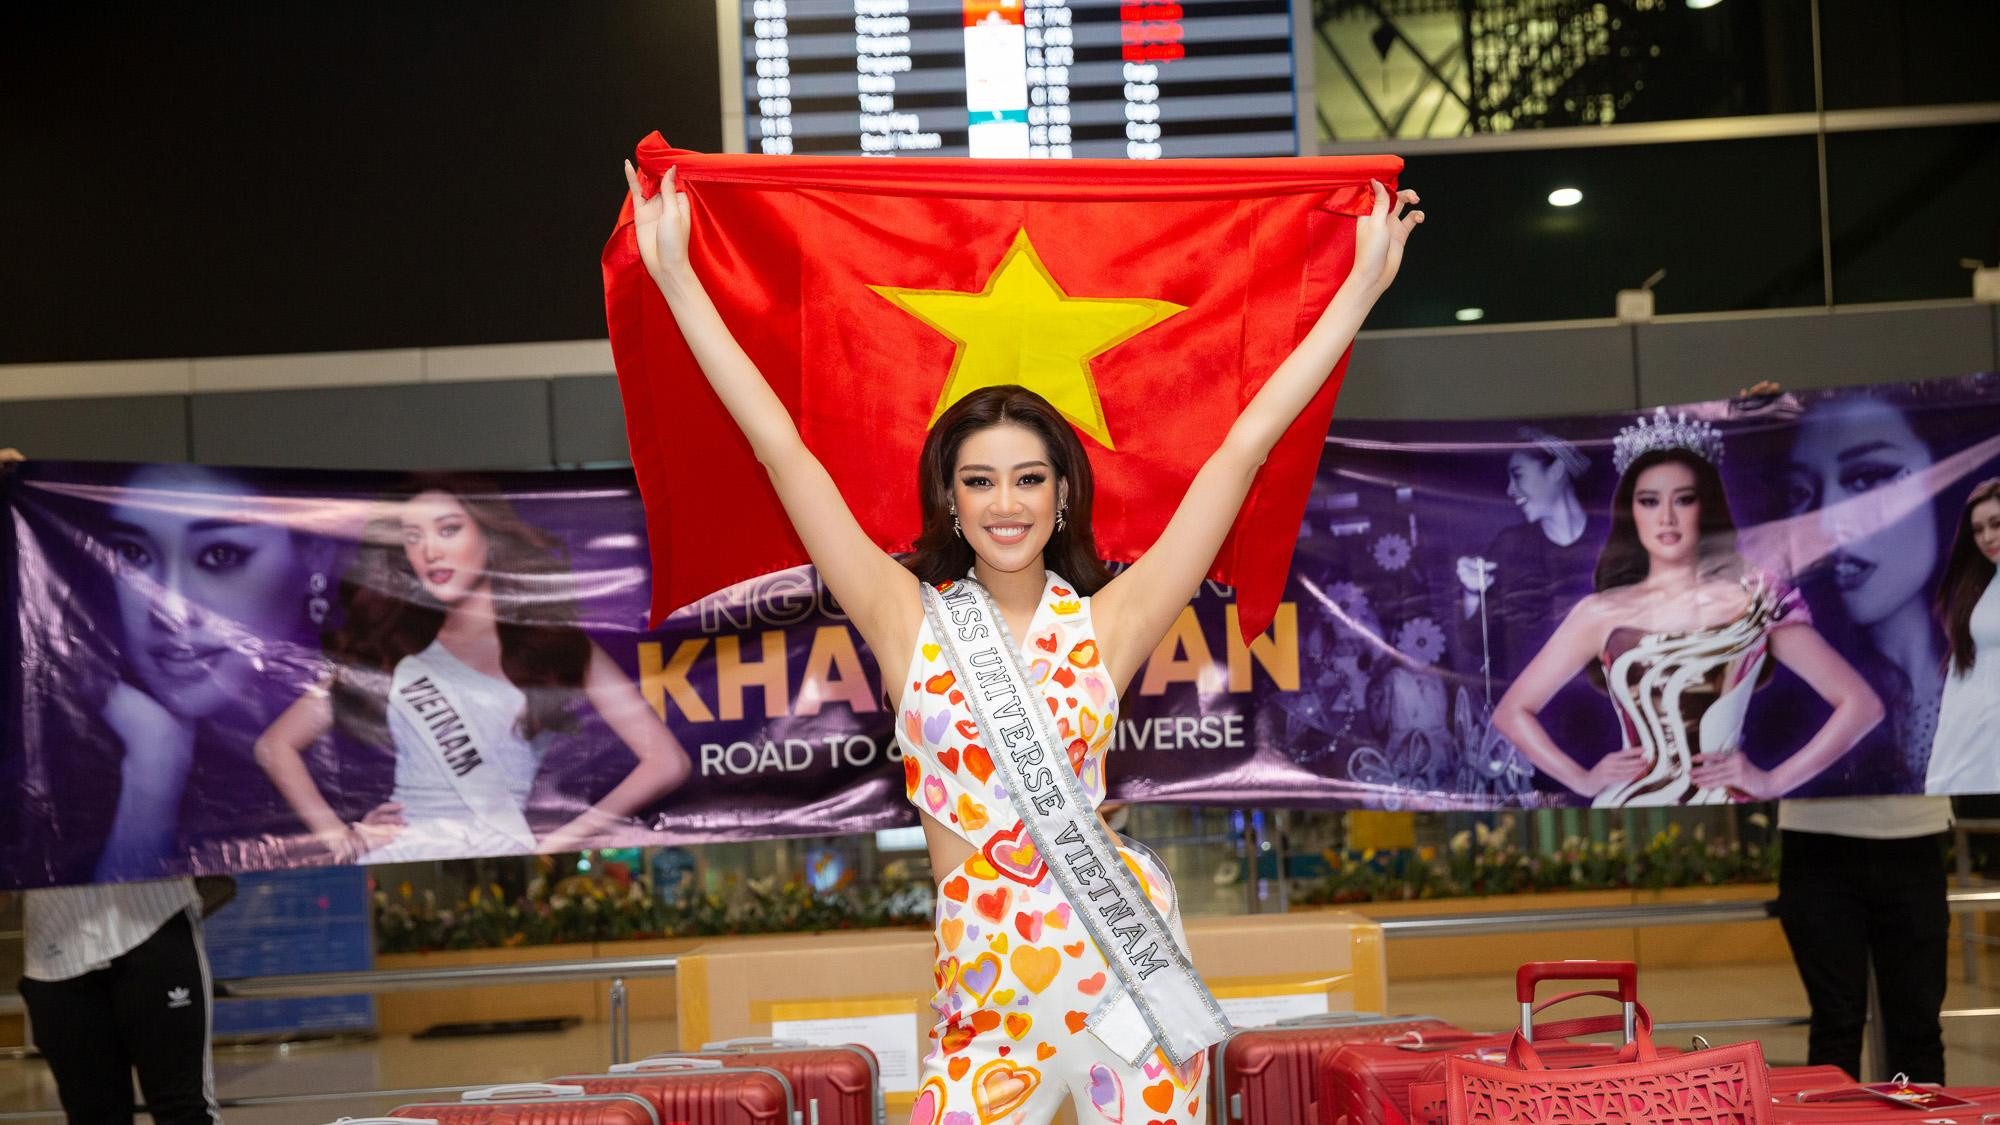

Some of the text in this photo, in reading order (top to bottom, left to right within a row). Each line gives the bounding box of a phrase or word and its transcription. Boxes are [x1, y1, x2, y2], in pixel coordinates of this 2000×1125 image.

[638, 602, 1300, 723] KHA AN
[400, 675, 483, 778] VIETNAM
[700, 740, 814, 777] ROAD
[822, 734, 876, 769] TO
[1110, 715, 1246, 751] IVERSE
[969, 646, 1066, 817] UNIVERSE
[1054, 820, 1170, 981] VIETNAM
